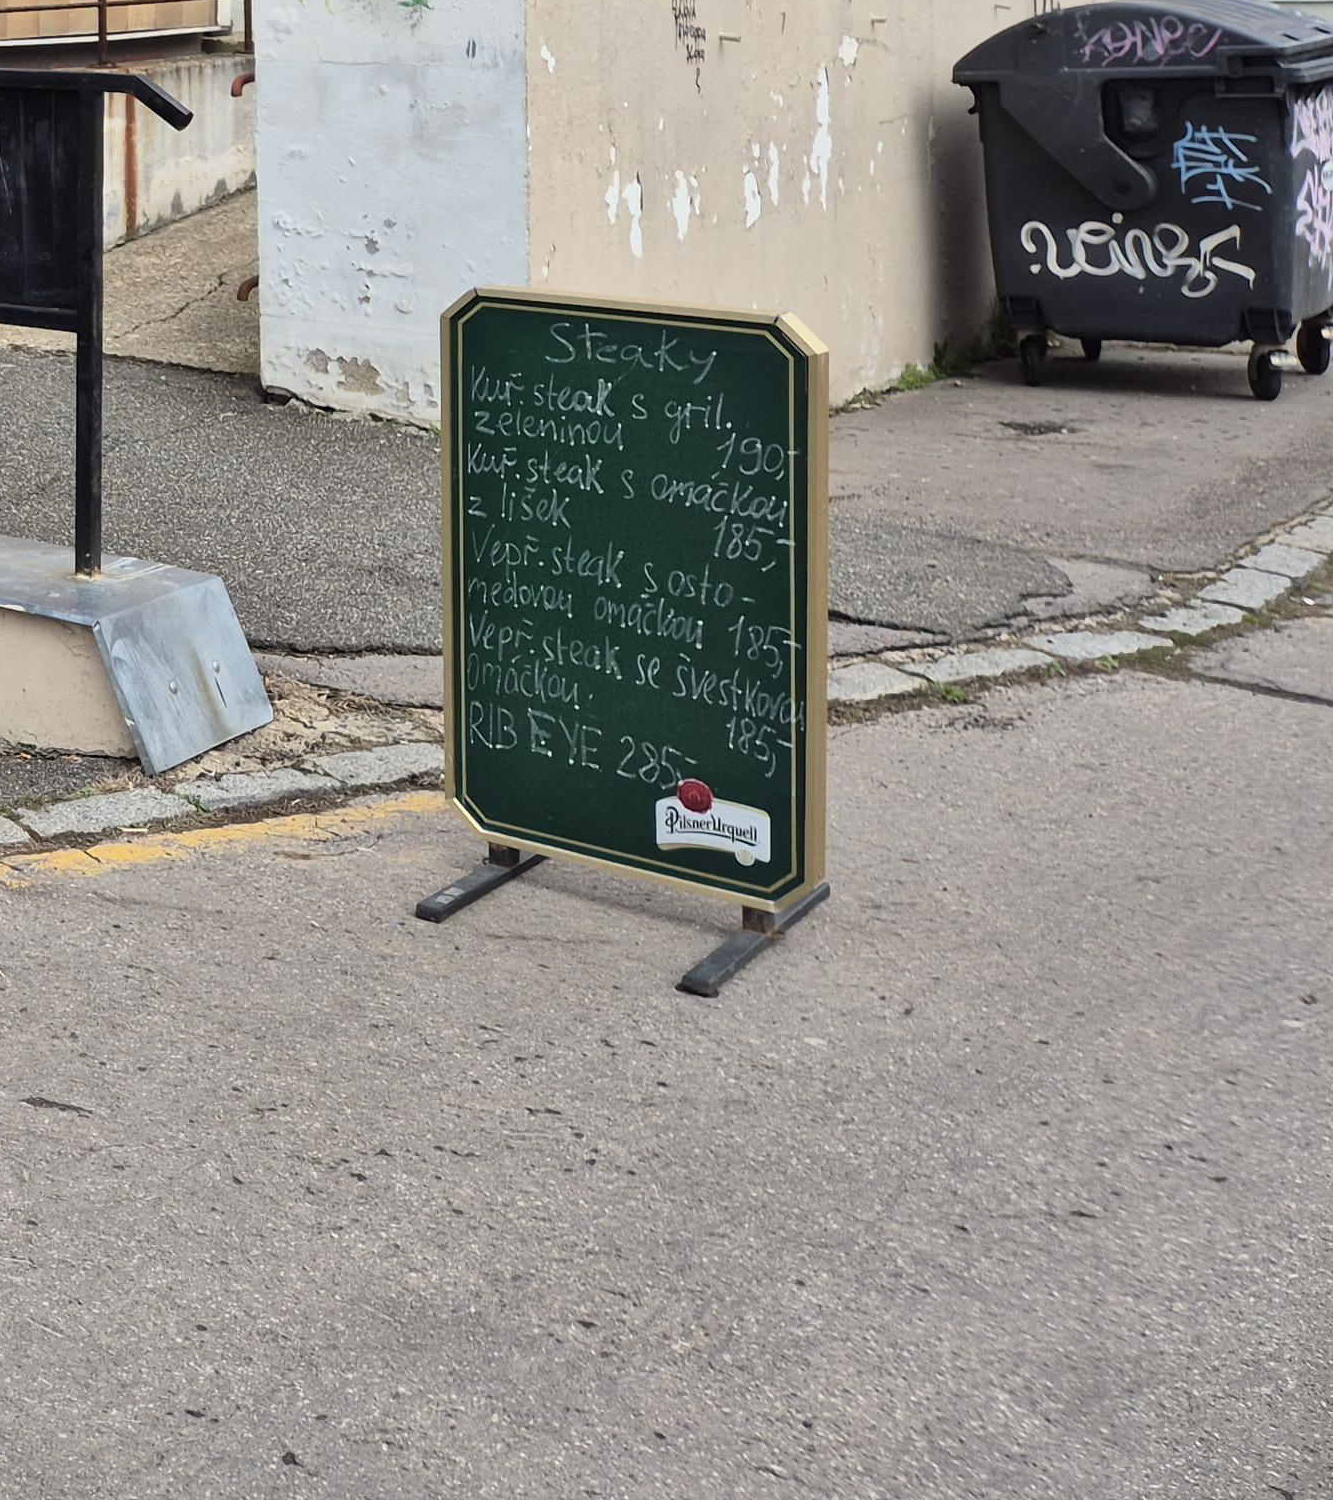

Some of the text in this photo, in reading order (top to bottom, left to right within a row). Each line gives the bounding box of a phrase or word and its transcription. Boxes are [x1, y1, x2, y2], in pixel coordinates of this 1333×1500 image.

[545, 323, 718, 384] Steaky
[474, 408, 624, 451] zeleninou
[533, 373, 615, 417] steak
[664, 392, 732, 444] gril.
[526, 450, 604, 494] steak
[501, 482, 571, 528] lišek
[552, 536, 625, 588] steak
[467, 570, 573, 618] medovou
[542, 627, 623, 680] steak
[635, 653, 660, 689] se
[672, 653, 805, 731] švestkovou
[469, 701, 518, 749] RIB
[527, 707, 603, 771] EYE
[664, 805, 758, 843] Pilsner Urquell
